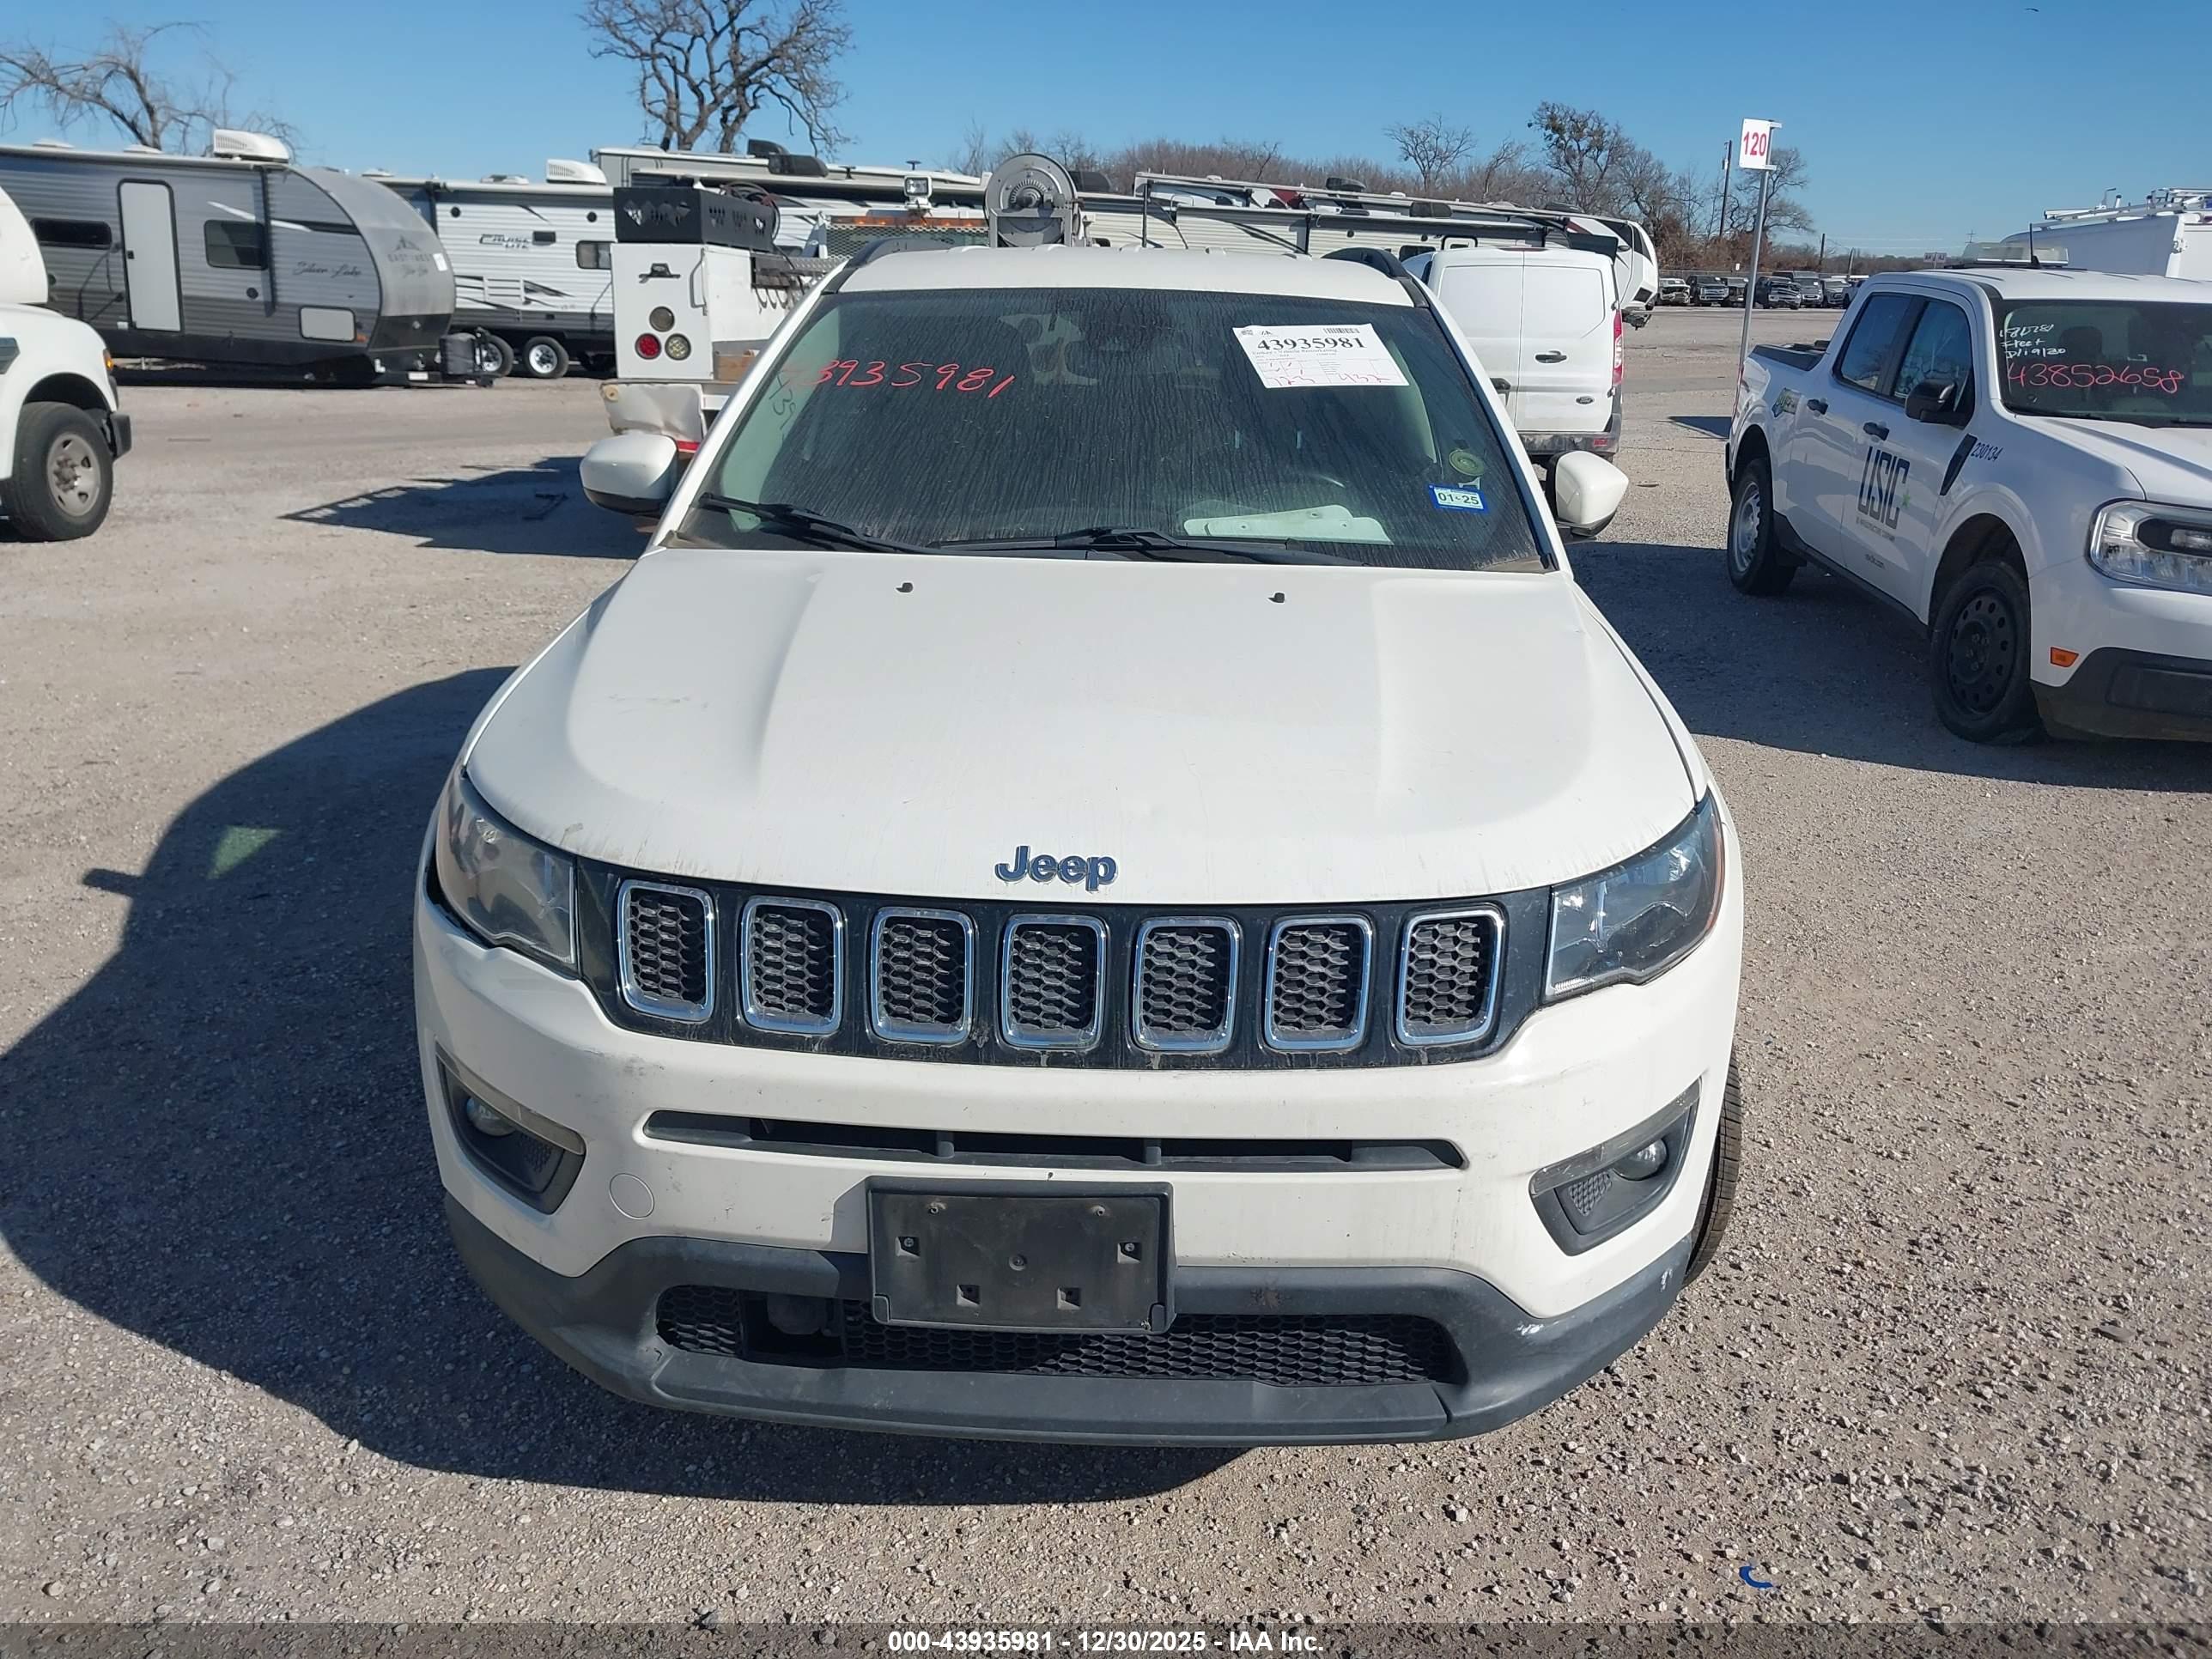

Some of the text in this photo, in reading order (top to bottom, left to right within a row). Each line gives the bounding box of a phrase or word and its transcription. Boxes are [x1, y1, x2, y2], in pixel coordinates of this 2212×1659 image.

[1744, 131, 1767, 156] 120
[1258, 337, 1367, 350] 43935981
[2008, 362, 2185, 395] 43852658
[1970, 441, 2004, 462] 230134
[994, 845, 1118, 892] Jeep
